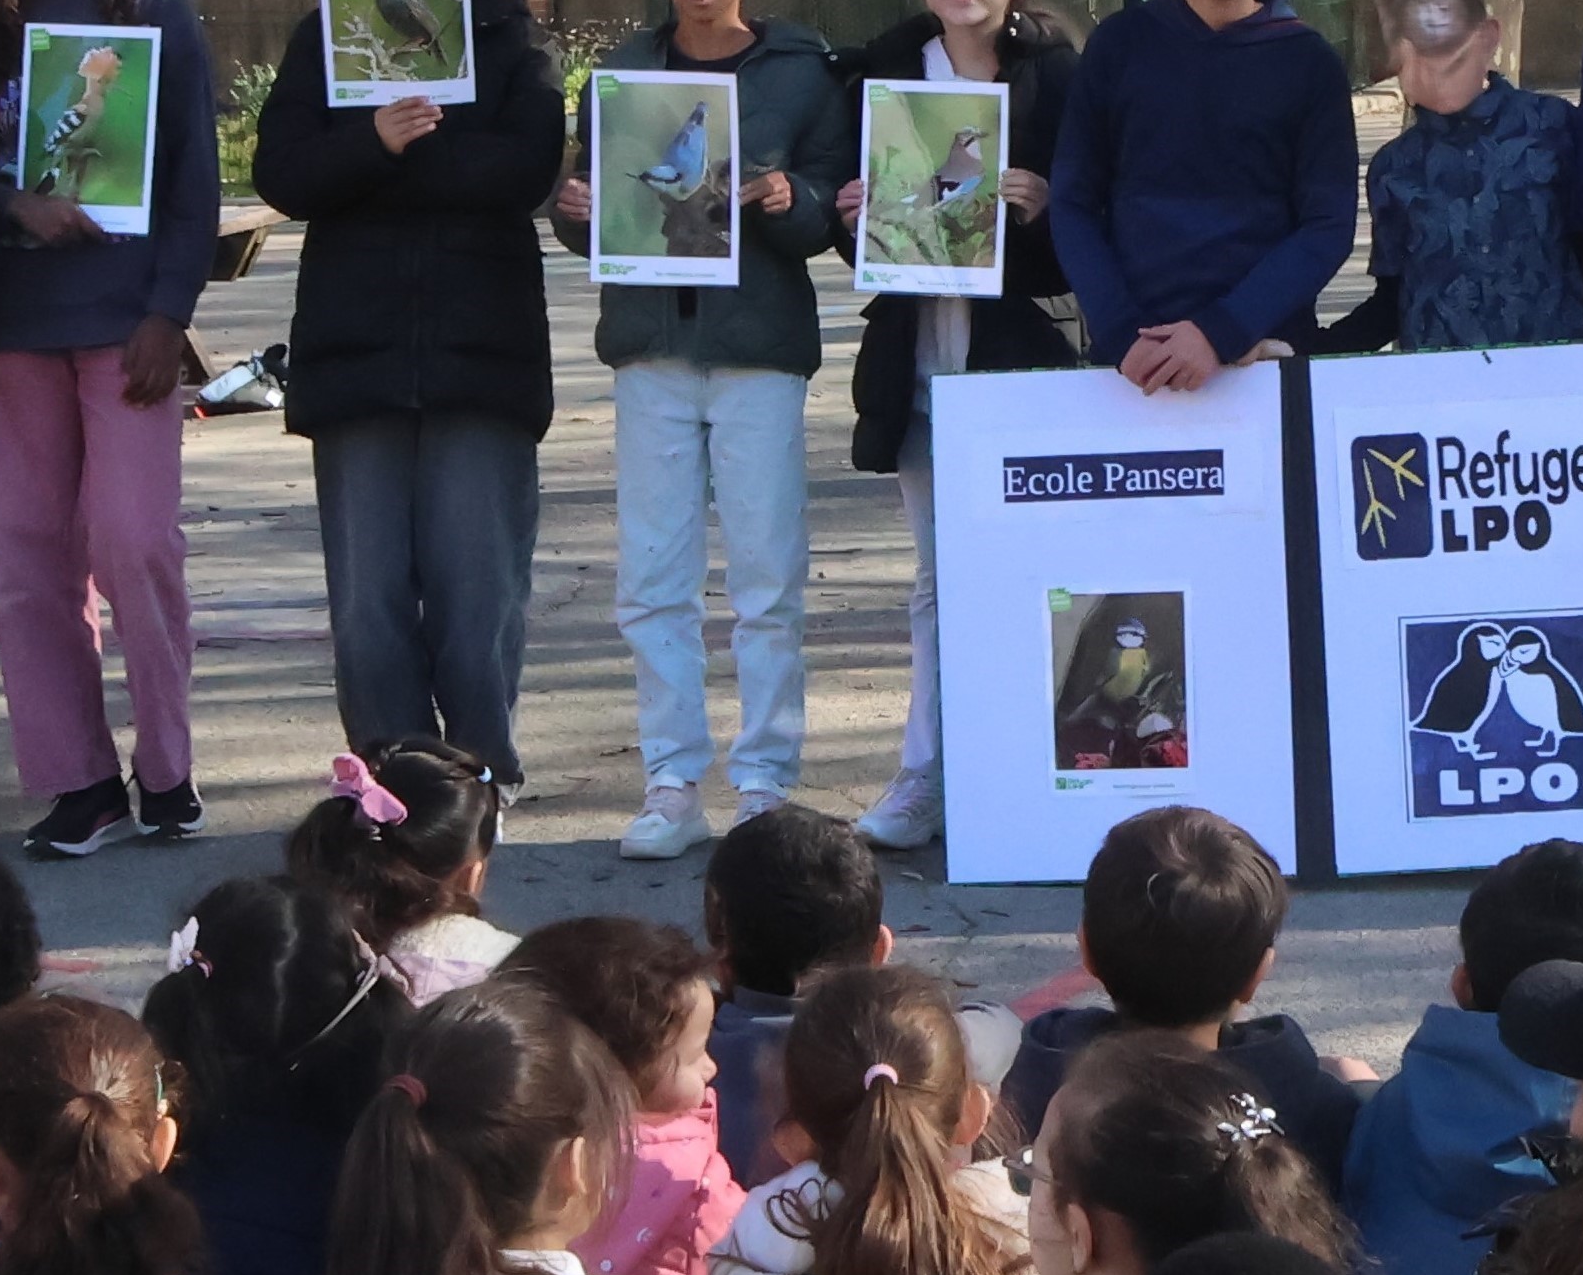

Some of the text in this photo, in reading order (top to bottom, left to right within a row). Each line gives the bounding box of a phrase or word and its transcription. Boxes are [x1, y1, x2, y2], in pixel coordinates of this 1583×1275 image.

[1004, 459, 1225, 501] Ecole Pansera
[1441, 500, 1552, 553] LPO
[1439, 761, 1580, 809] LPO
